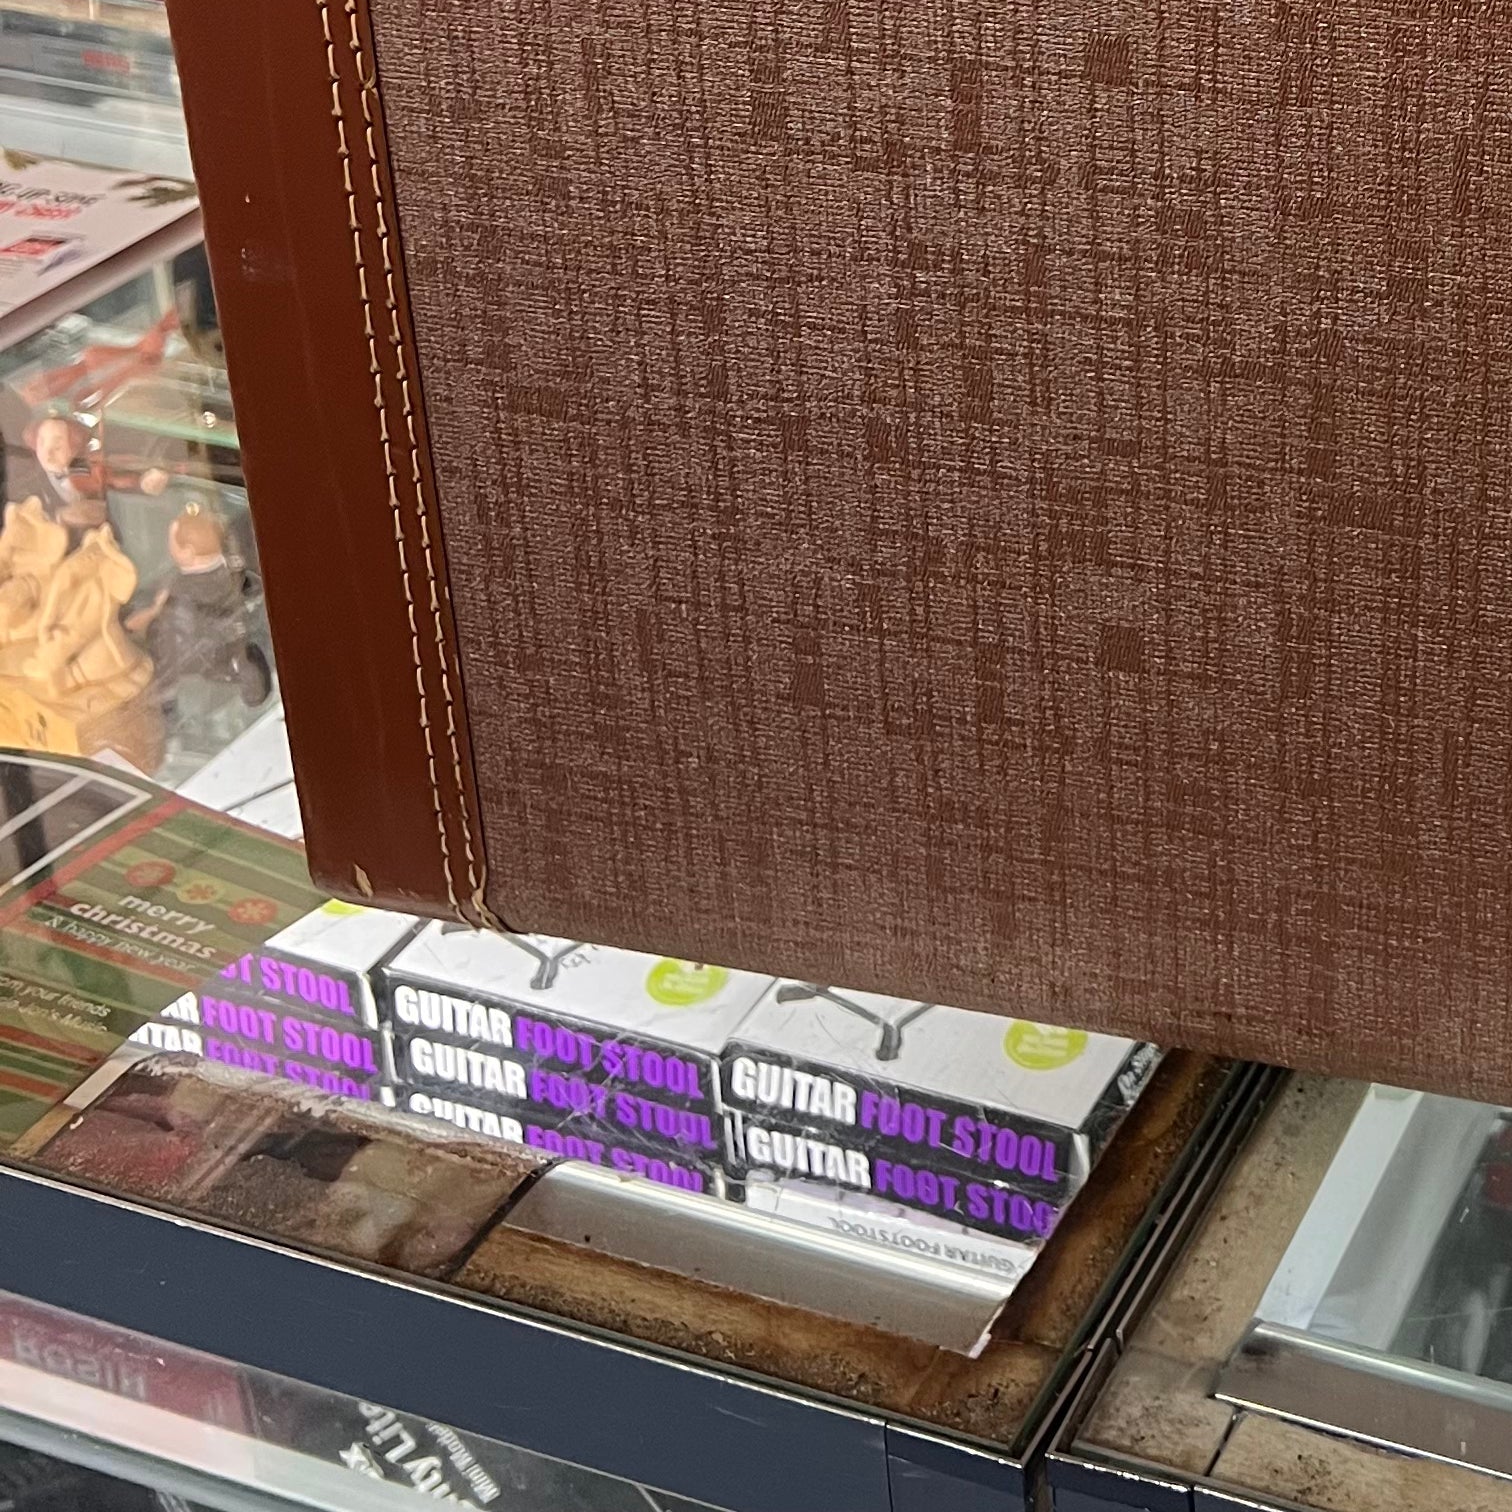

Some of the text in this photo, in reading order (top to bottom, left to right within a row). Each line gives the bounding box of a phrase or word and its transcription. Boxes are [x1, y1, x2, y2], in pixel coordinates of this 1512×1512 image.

[64, 918, 113, 949] happy
[116, 938, 154, 962] new
[152, 949, 199, 974] year
[70, 901, 218, 960] christmas
[118, 894, 216, 935] merry
[260, 956, 356, 1018] STOOL
[202, 995, 278, 1045] FOOT
[283, 1014, 379, 1076] STOOL
[394, 985, 706, 1101] GUITAR FOOT STOOL
[408, 1037, 719, 1151] GUITAR FOOT STOOL
[731, 1057, 1061, 1183] GUITAR FOOT STOOL
[746, 1126, 873, 1190] GUITAR
[873, 1159, 961, 1214] FOOT
